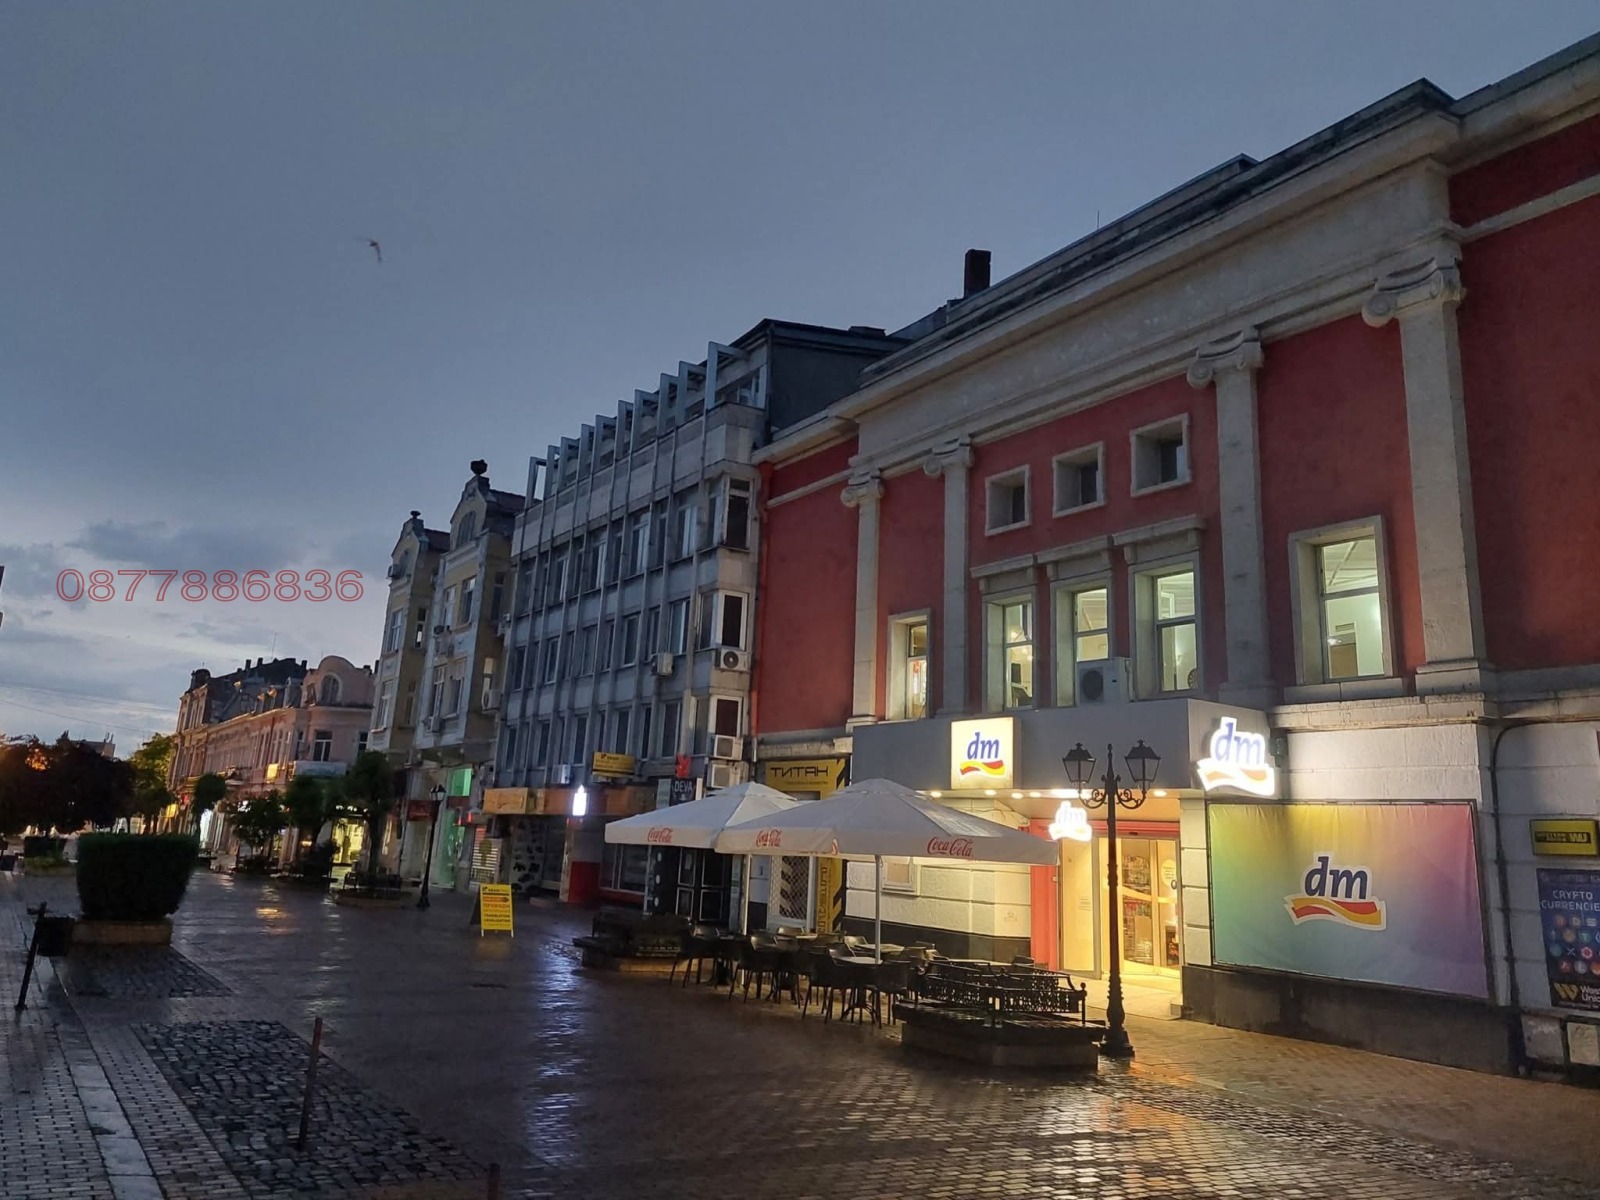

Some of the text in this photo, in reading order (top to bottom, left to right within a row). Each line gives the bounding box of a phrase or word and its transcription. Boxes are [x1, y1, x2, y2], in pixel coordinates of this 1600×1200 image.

[966, 731, 1000, 760] dm
[1215, 722, 1261, 765] dm
[674, 780, 693, 793] DEVA
[1304, 856, 1367, 899] dm
[1552, 890, 1594, 901] CRYPTO
